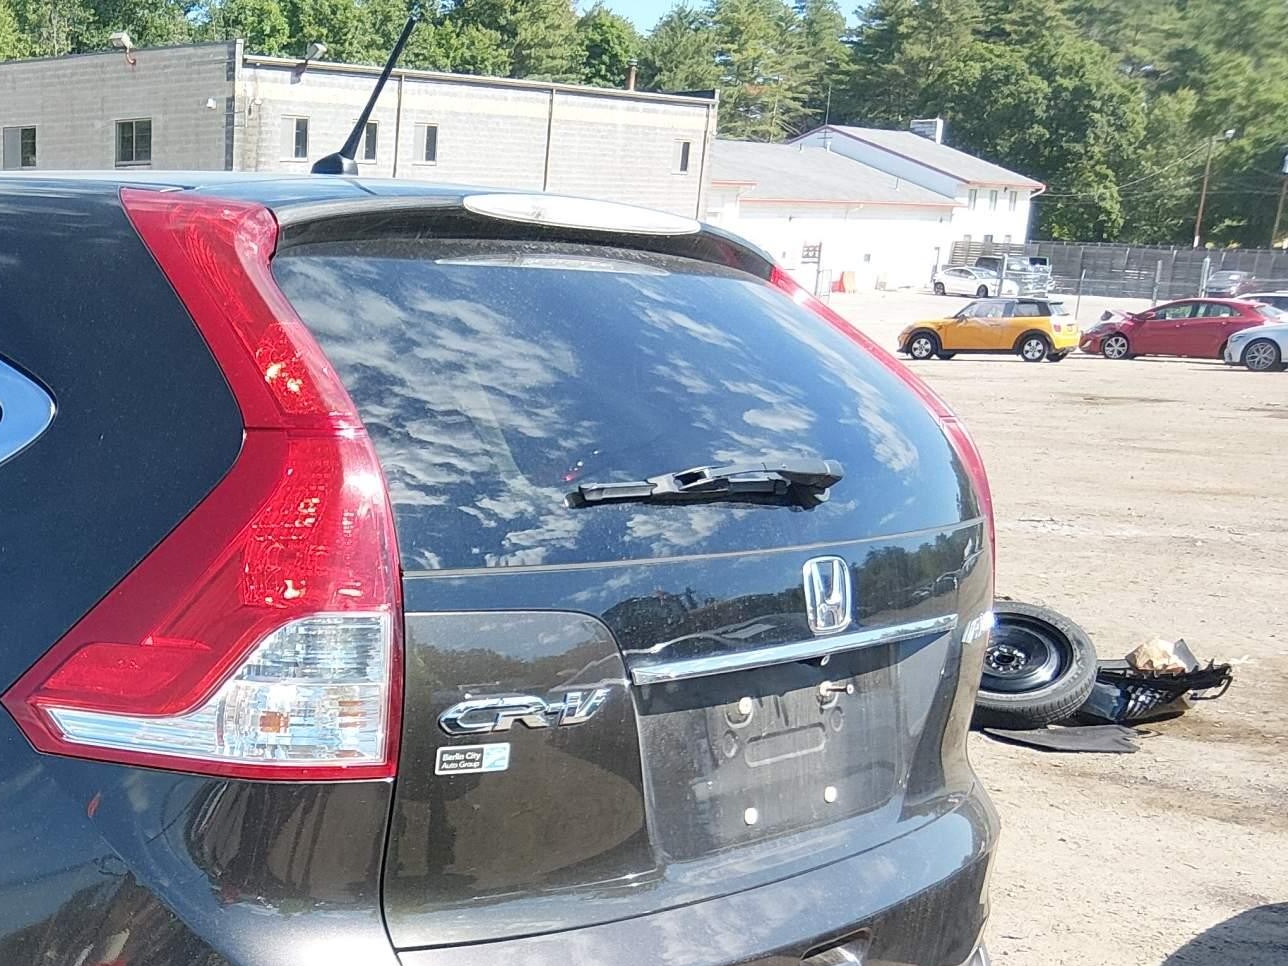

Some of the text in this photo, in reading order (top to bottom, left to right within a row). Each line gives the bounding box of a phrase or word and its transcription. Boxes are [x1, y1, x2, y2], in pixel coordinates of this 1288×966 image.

[438, 687, 612, 736] CR-V
[442, 752, 481, 761] Berlin City
[459, 761, 480, 769] Group
